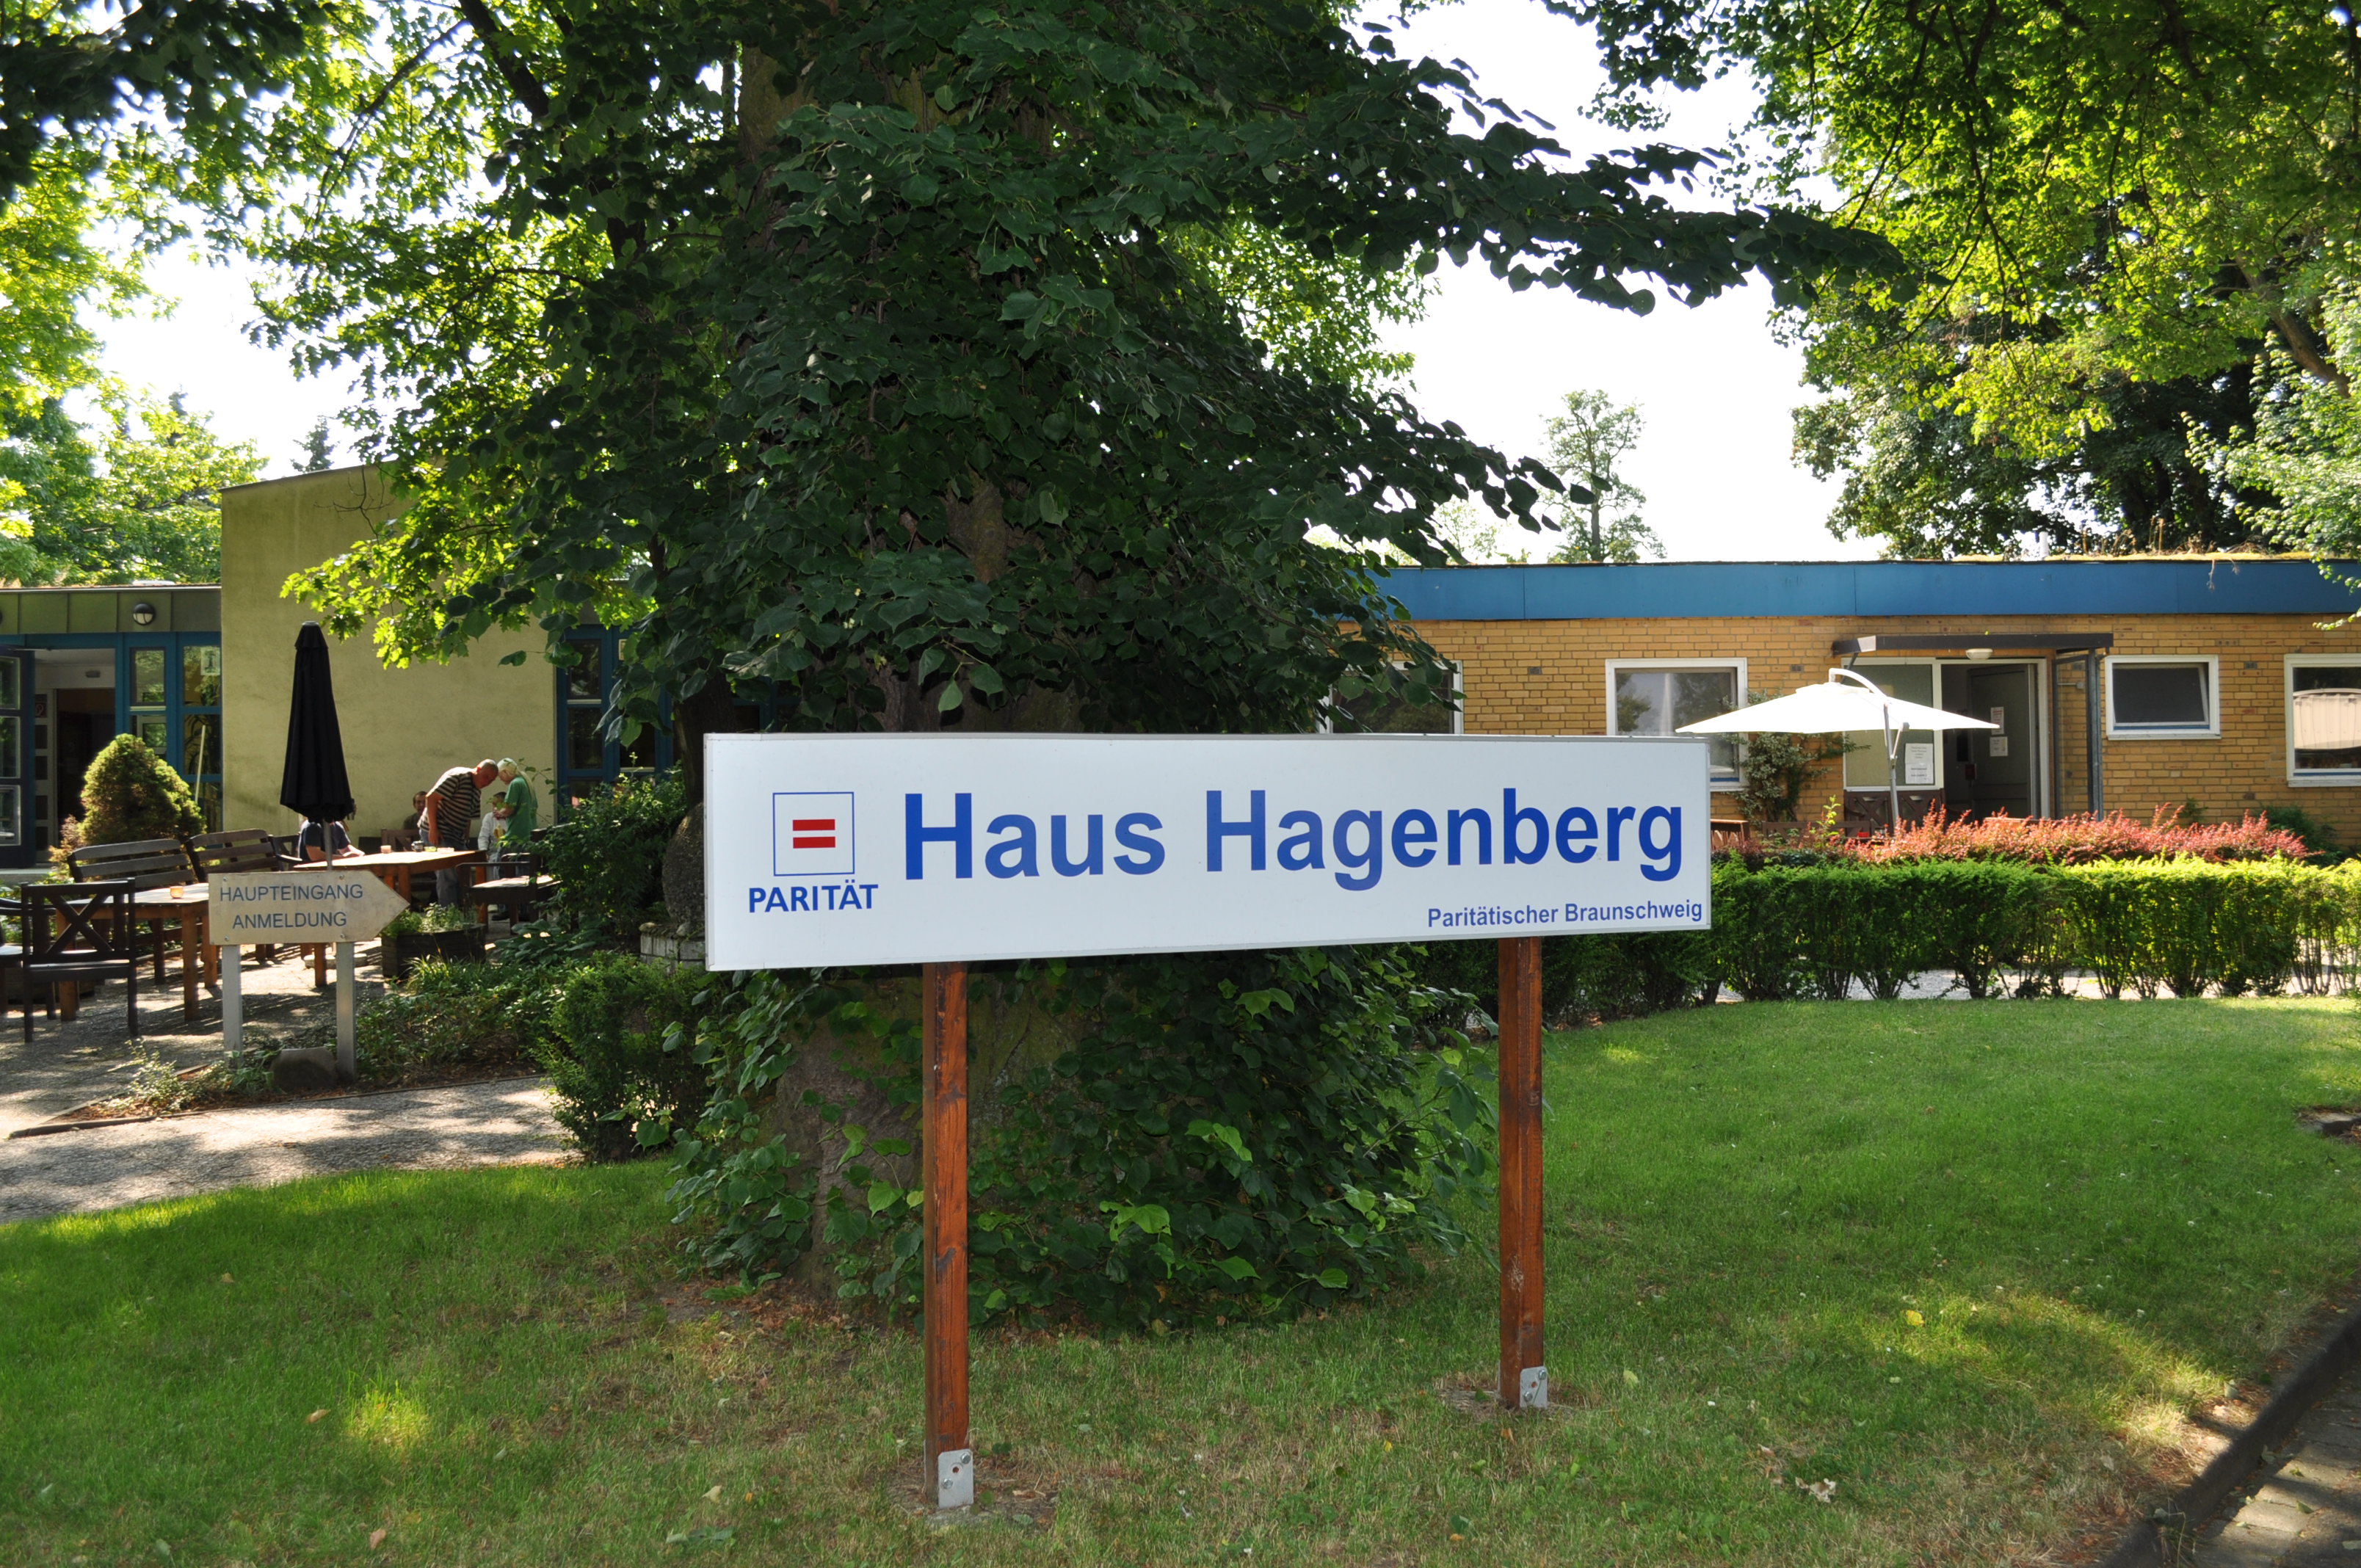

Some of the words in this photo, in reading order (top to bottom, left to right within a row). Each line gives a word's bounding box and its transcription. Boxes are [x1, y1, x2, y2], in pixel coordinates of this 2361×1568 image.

[905, 793, 1166, 880] Haus
[1206, 788, 1683, 891] Hagenberg
[220, 884, 363, 901] HAUPTEINGANG
[749, 879, 880, 913] PARITÄT
[232, 912, 347, 929] ANMELDUNG
[1429, 906, 1559, 928] Paritätischer
[1565, 899, 1703, 923] Braunschweig
